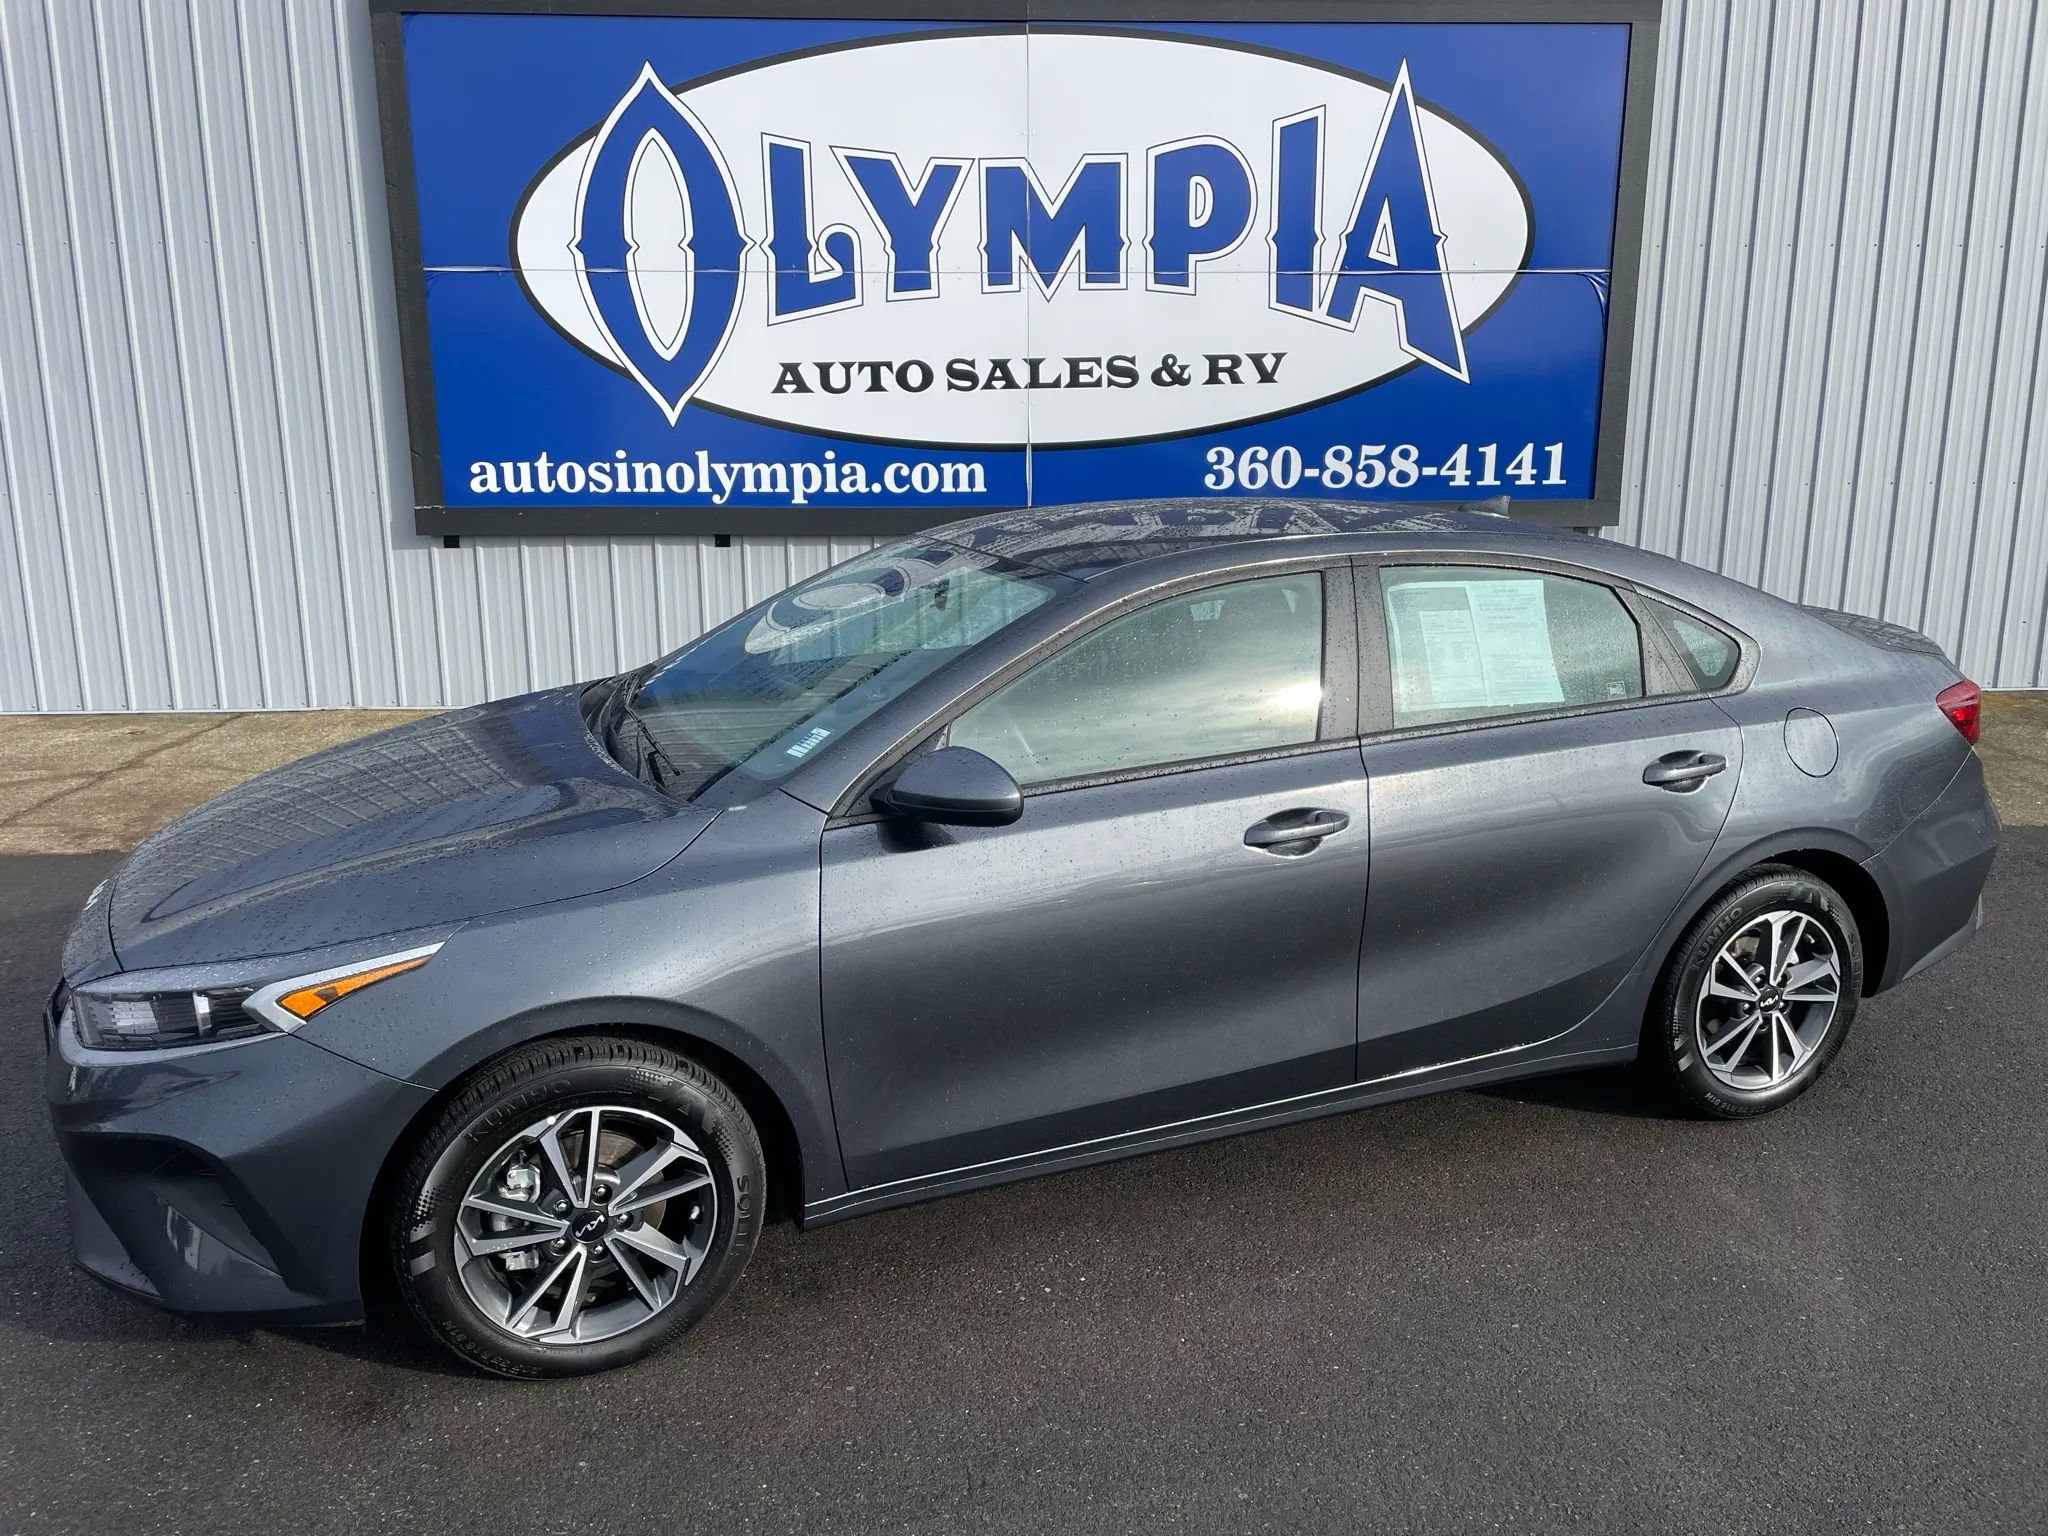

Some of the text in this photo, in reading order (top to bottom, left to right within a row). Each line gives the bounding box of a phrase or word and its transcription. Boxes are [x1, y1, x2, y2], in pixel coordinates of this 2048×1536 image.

[567, 56, 1471, 428] OLYMPIA
[770, 352, 1288, 395] AUTO SALES & RV
[469, 449, 987, 504] autosinolympia.com
[1204, 441, 1567, 490] 360-858-4141
[1691, 906, 1744, 970] KUMHO
[463, 1078, 571, 1144] KUMHO
